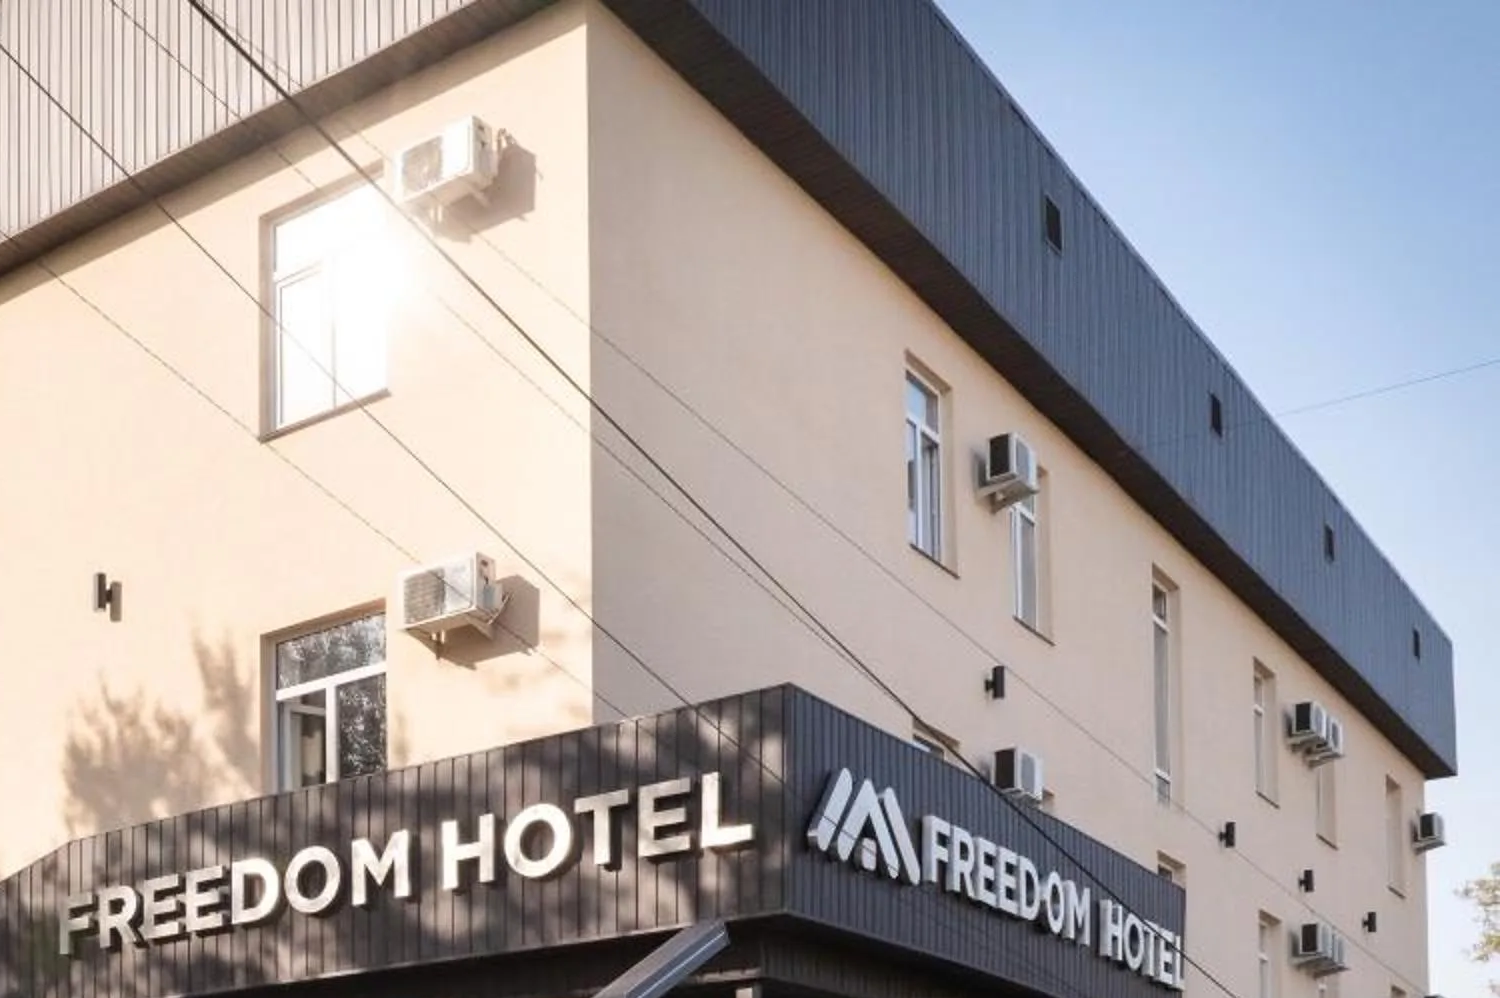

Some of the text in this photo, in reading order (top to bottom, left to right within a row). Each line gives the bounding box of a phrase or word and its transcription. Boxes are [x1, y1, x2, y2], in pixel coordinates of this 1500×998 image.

[59, 771, 754, 955] FREEDOM HOTEL
[921, 815, 1185, 991] FREEDOM HOTEL
